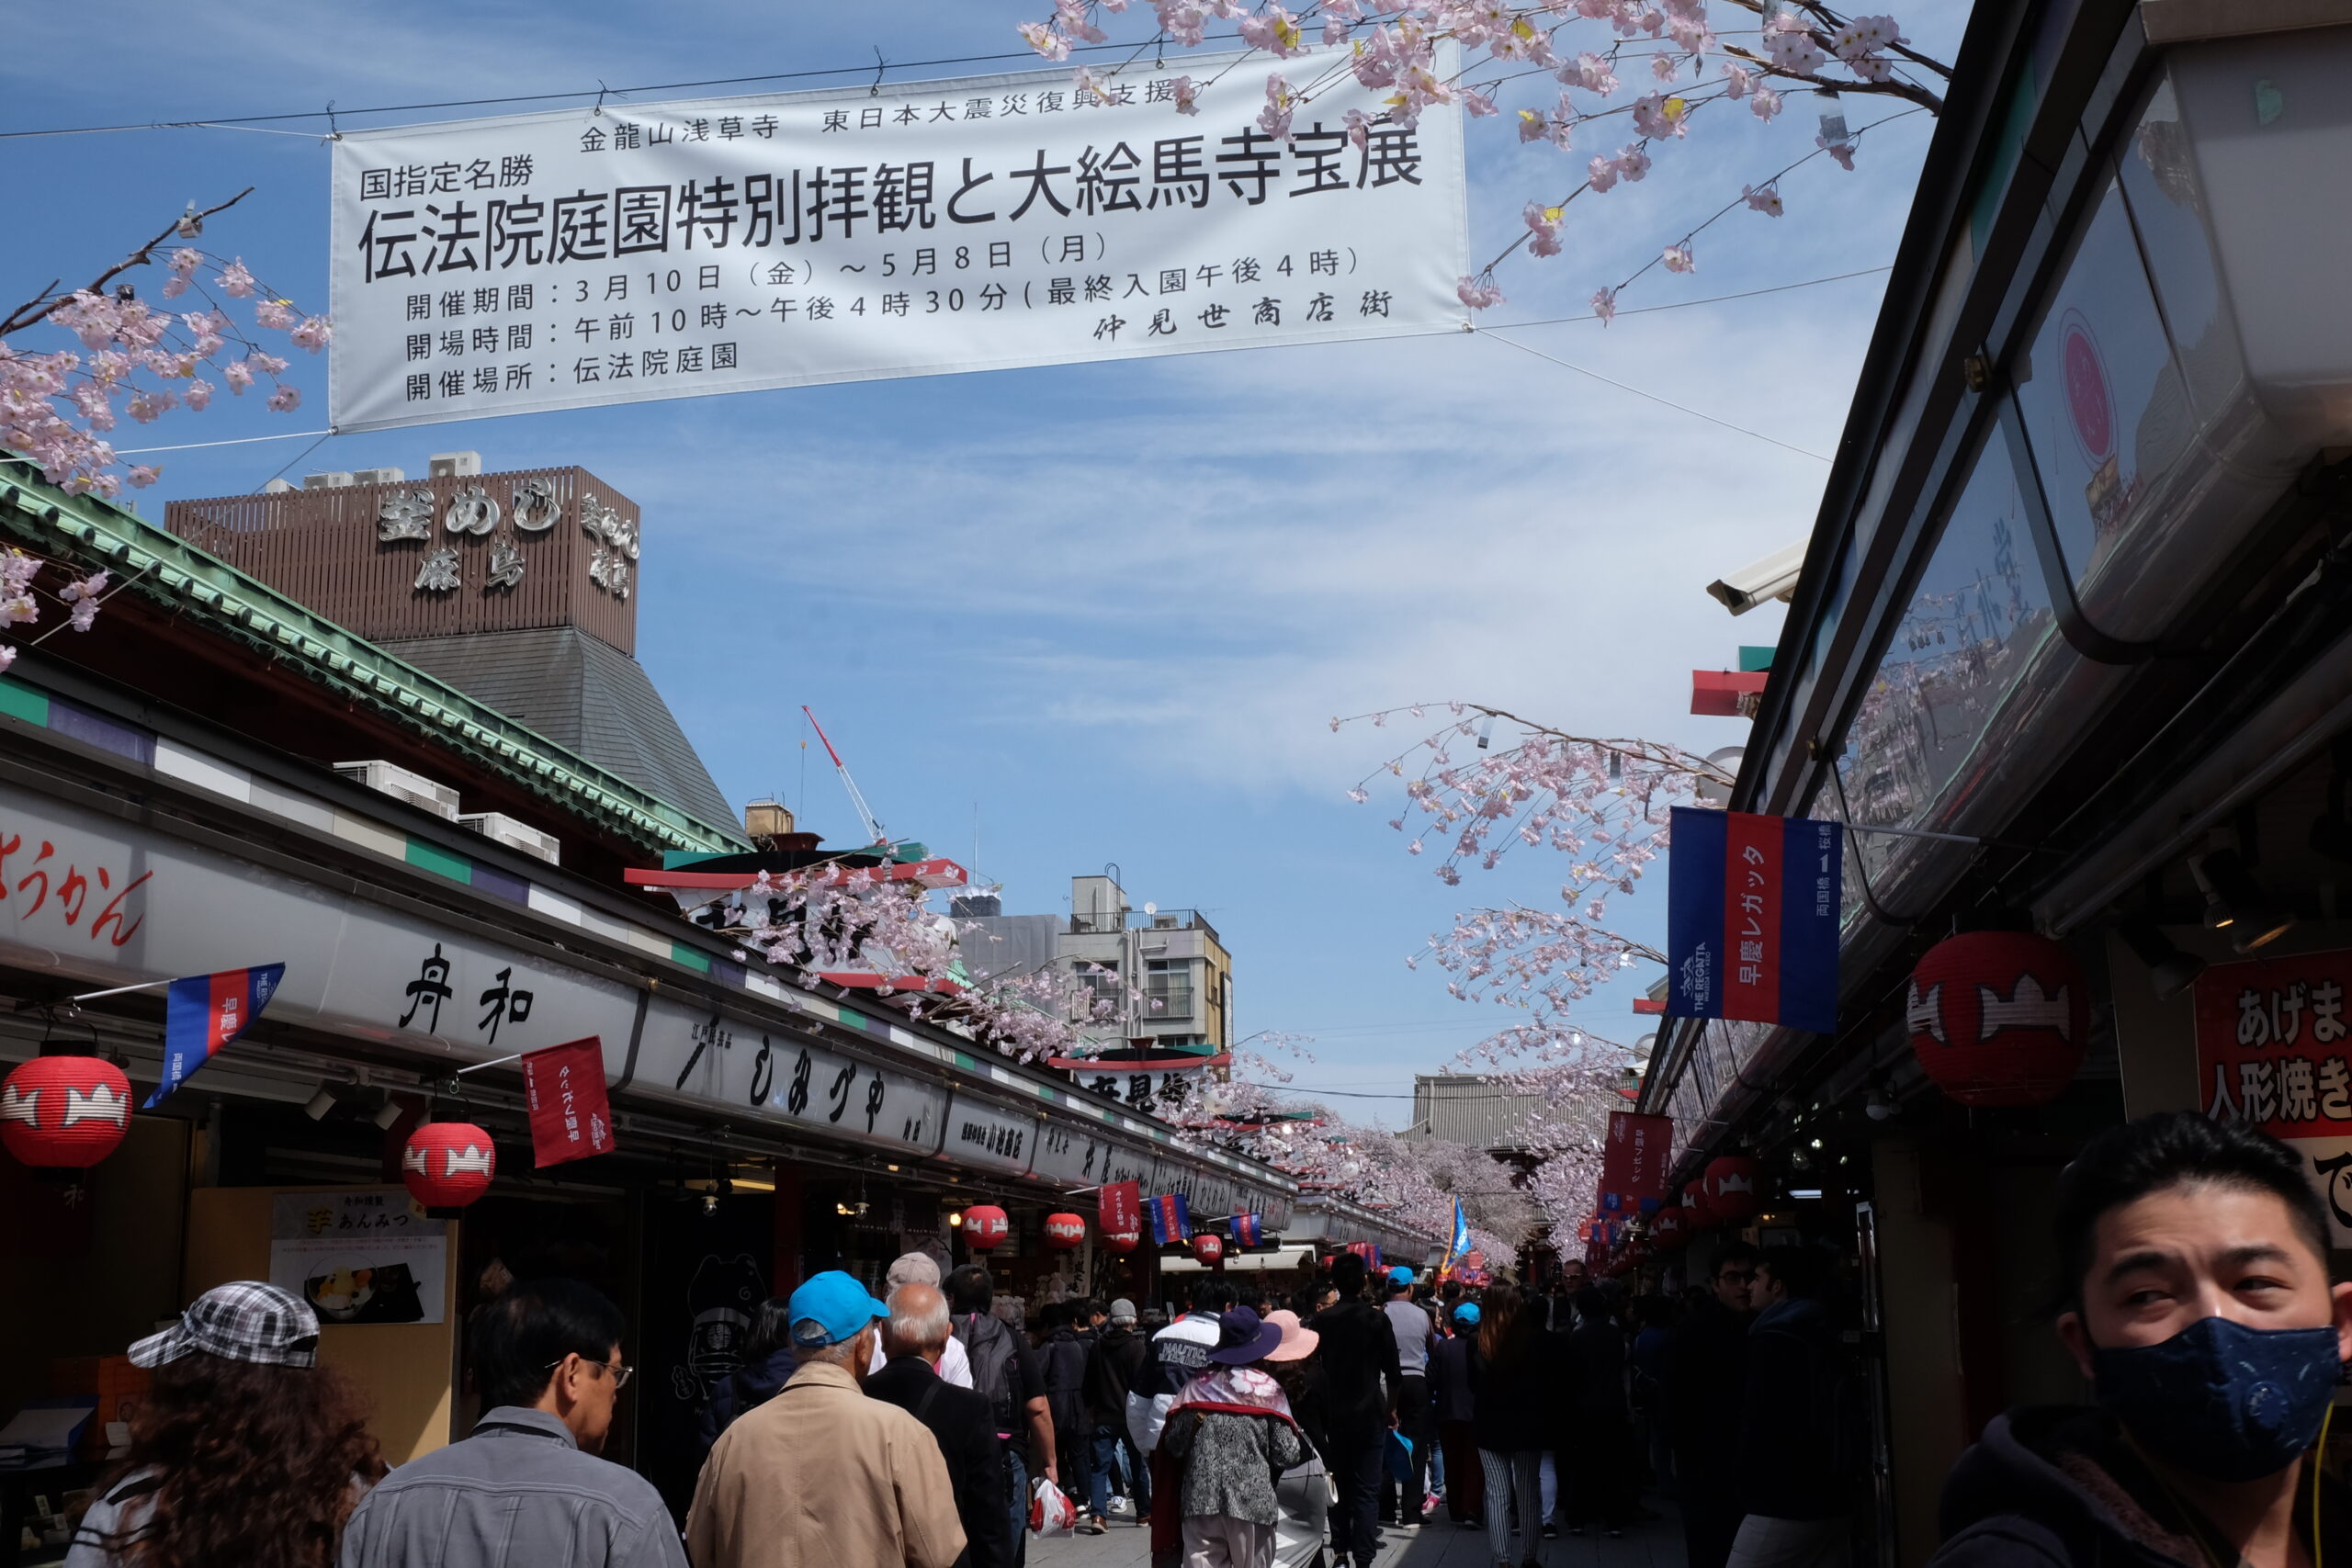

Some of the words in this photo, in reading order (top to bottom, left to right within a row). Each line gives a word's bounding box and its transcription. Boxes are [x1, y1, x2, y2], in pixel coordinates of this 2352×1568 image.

[581, 115, 780, 152] 金龍山浅草寺
[357, 116, 1423, 284] 伝法院庭園特別拝観と大絵馬寺宝展
[359, 154, 534, 201] 国指定名勝
[1093, 289, 1393, 343] 仲見世商店街
[379, 477, 561, 542] 釜めし
[1739, 845, 1765, 986] 早慶レガッタ
[399, 942, 534, 1044] 舟和
[1695, 942, 1705, 991] REGATTA
[1694, 992, 1704, 1011] THE
